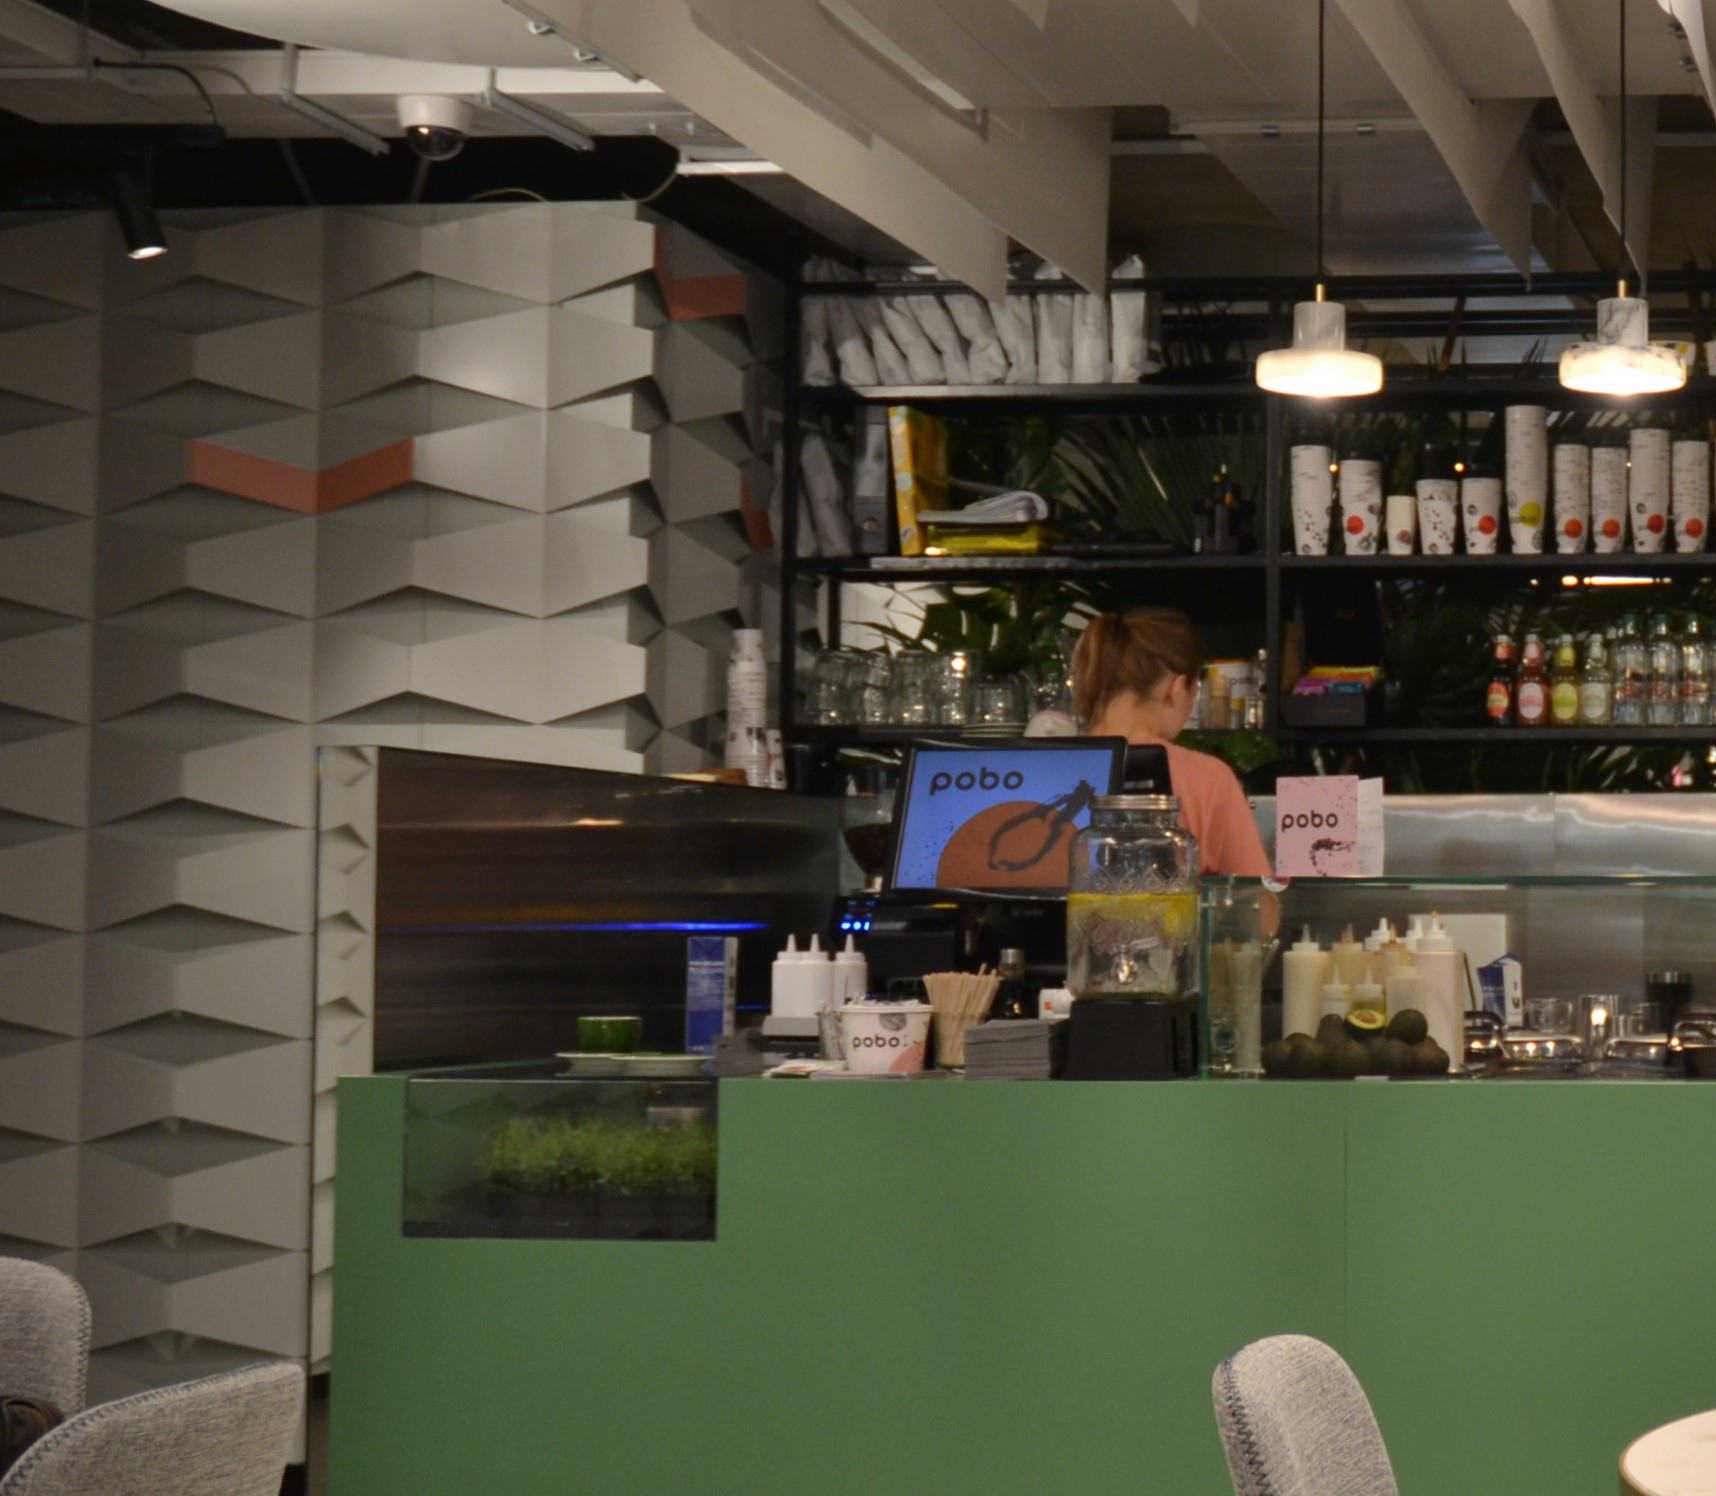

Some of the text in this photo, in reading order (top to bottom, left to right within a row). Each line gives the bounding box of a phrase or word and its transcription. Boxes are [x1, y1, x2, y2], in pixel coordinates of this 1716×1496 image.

[929, 767, 1024, 796] pobo
[1281, 809, 1338, 832] pobo
[852, 1033, 900, 1050] pobo
